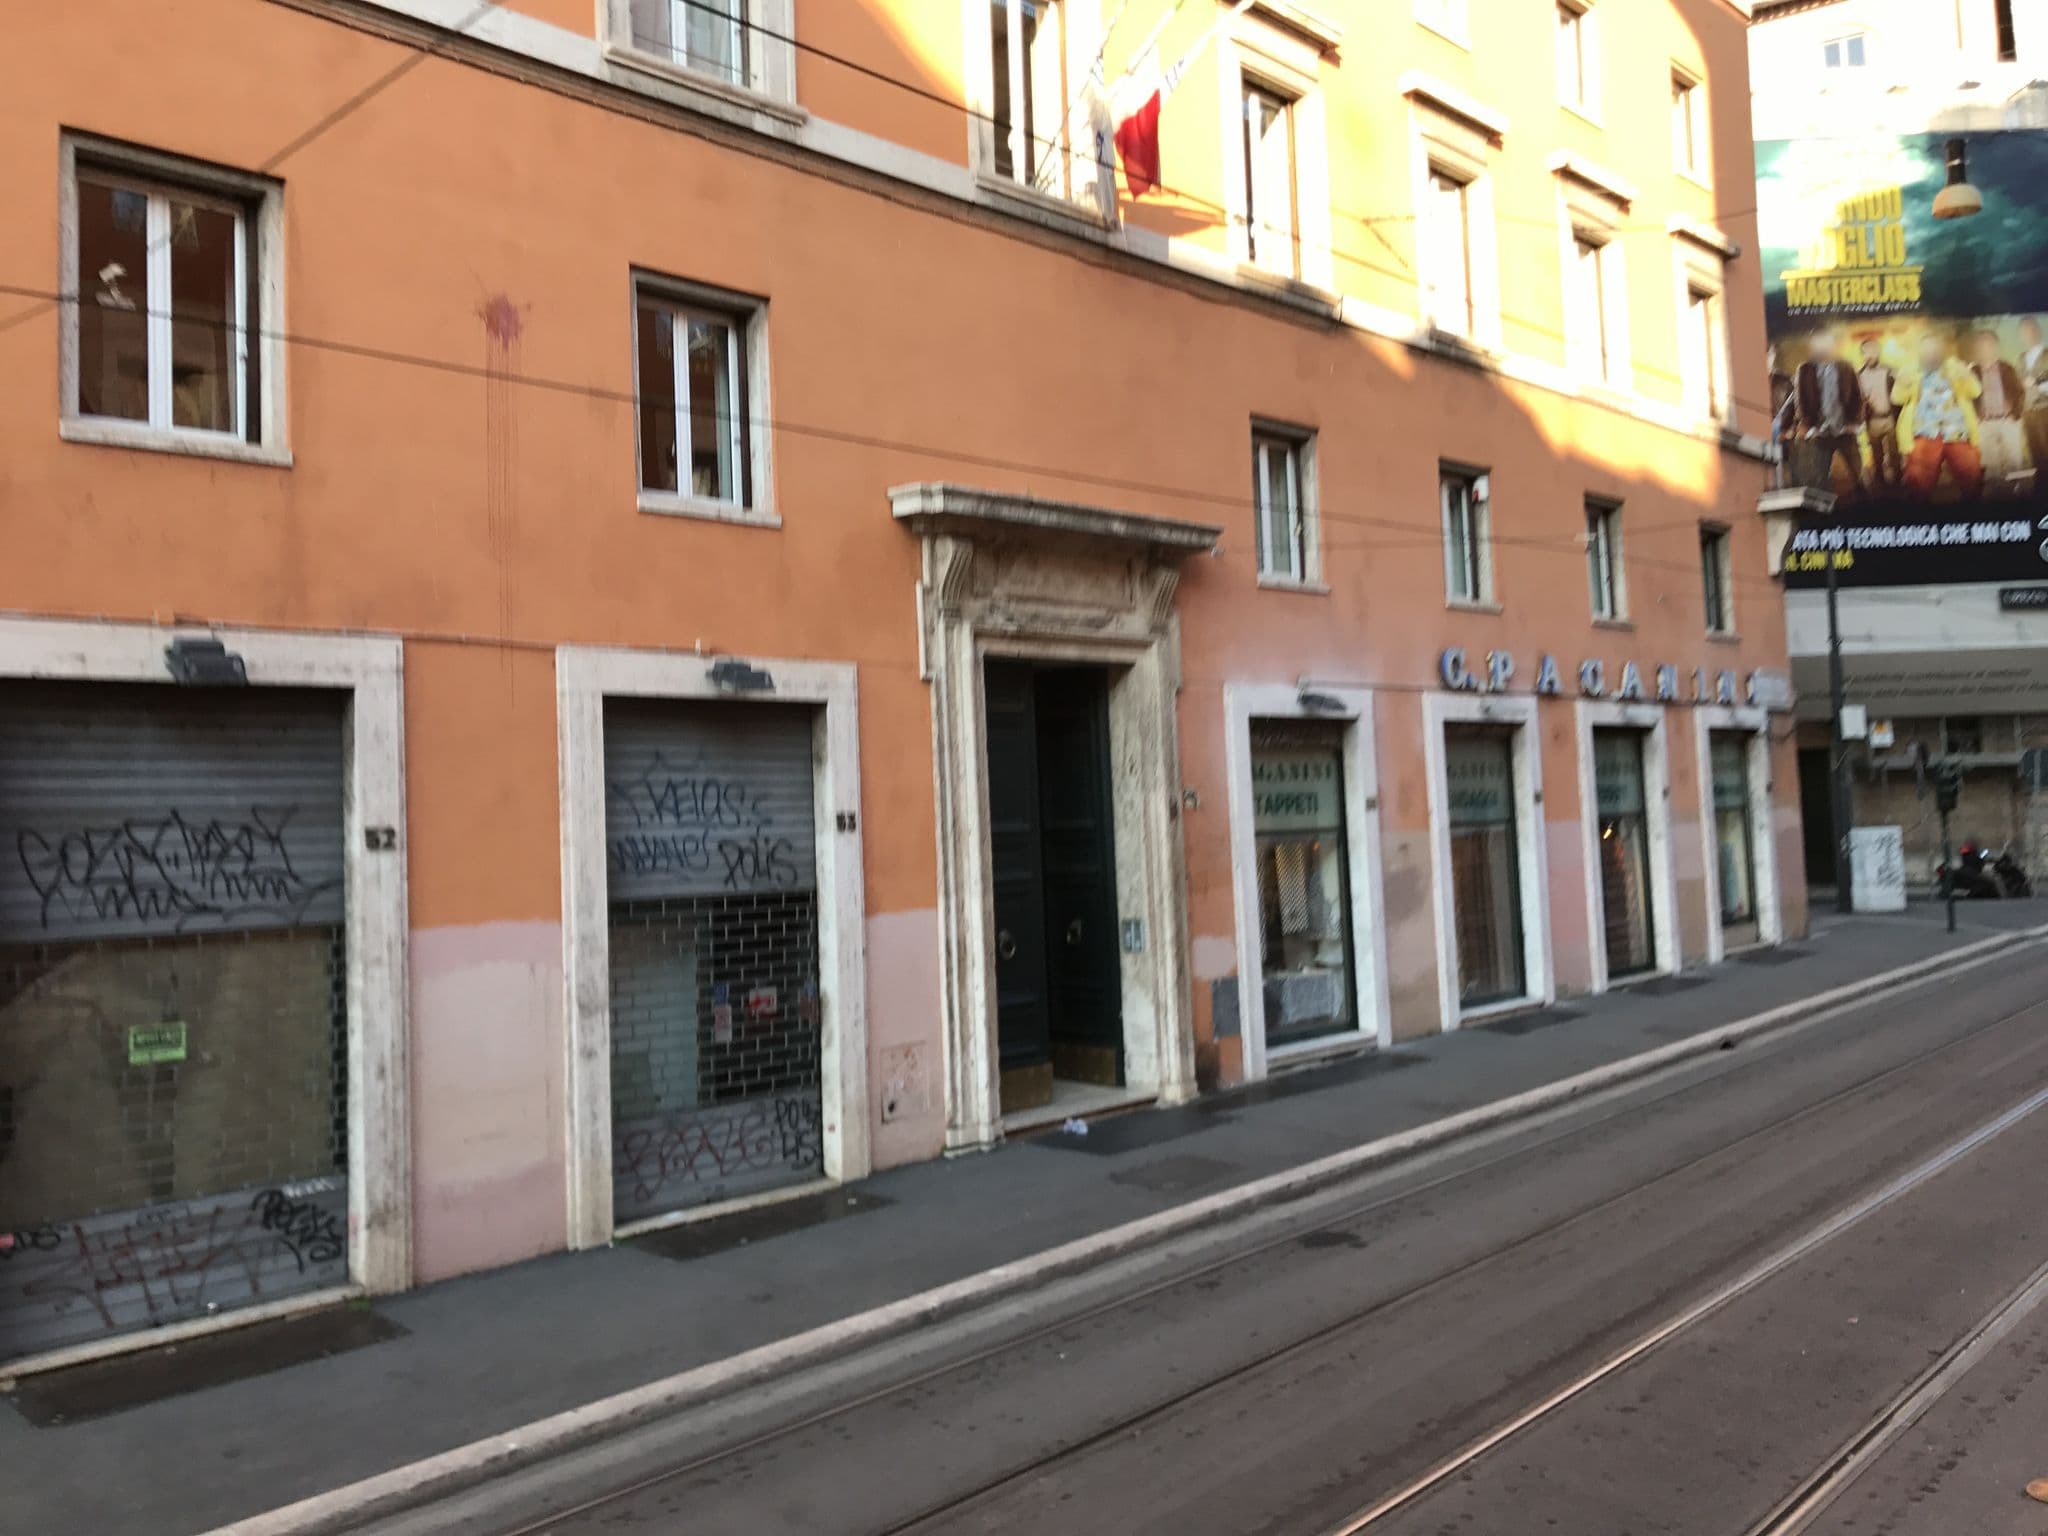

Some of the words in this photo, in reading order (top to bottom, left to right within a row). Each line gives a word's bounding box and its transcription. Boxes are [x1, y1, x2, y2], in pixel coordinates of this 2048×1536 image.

[1803, 222, 1906, 268] OGLIO
[1787, 273, 1921, 307] MASTERCLASS
[1846, 522, 1939, 549] TECNOLOGICA
[1940, 522, 1970, 545] CHE
[1970, 521, 2000, 544] MAI
[2000, 519, 2032, 543] CON
[1800, 549, 1855, 571] CINMA
